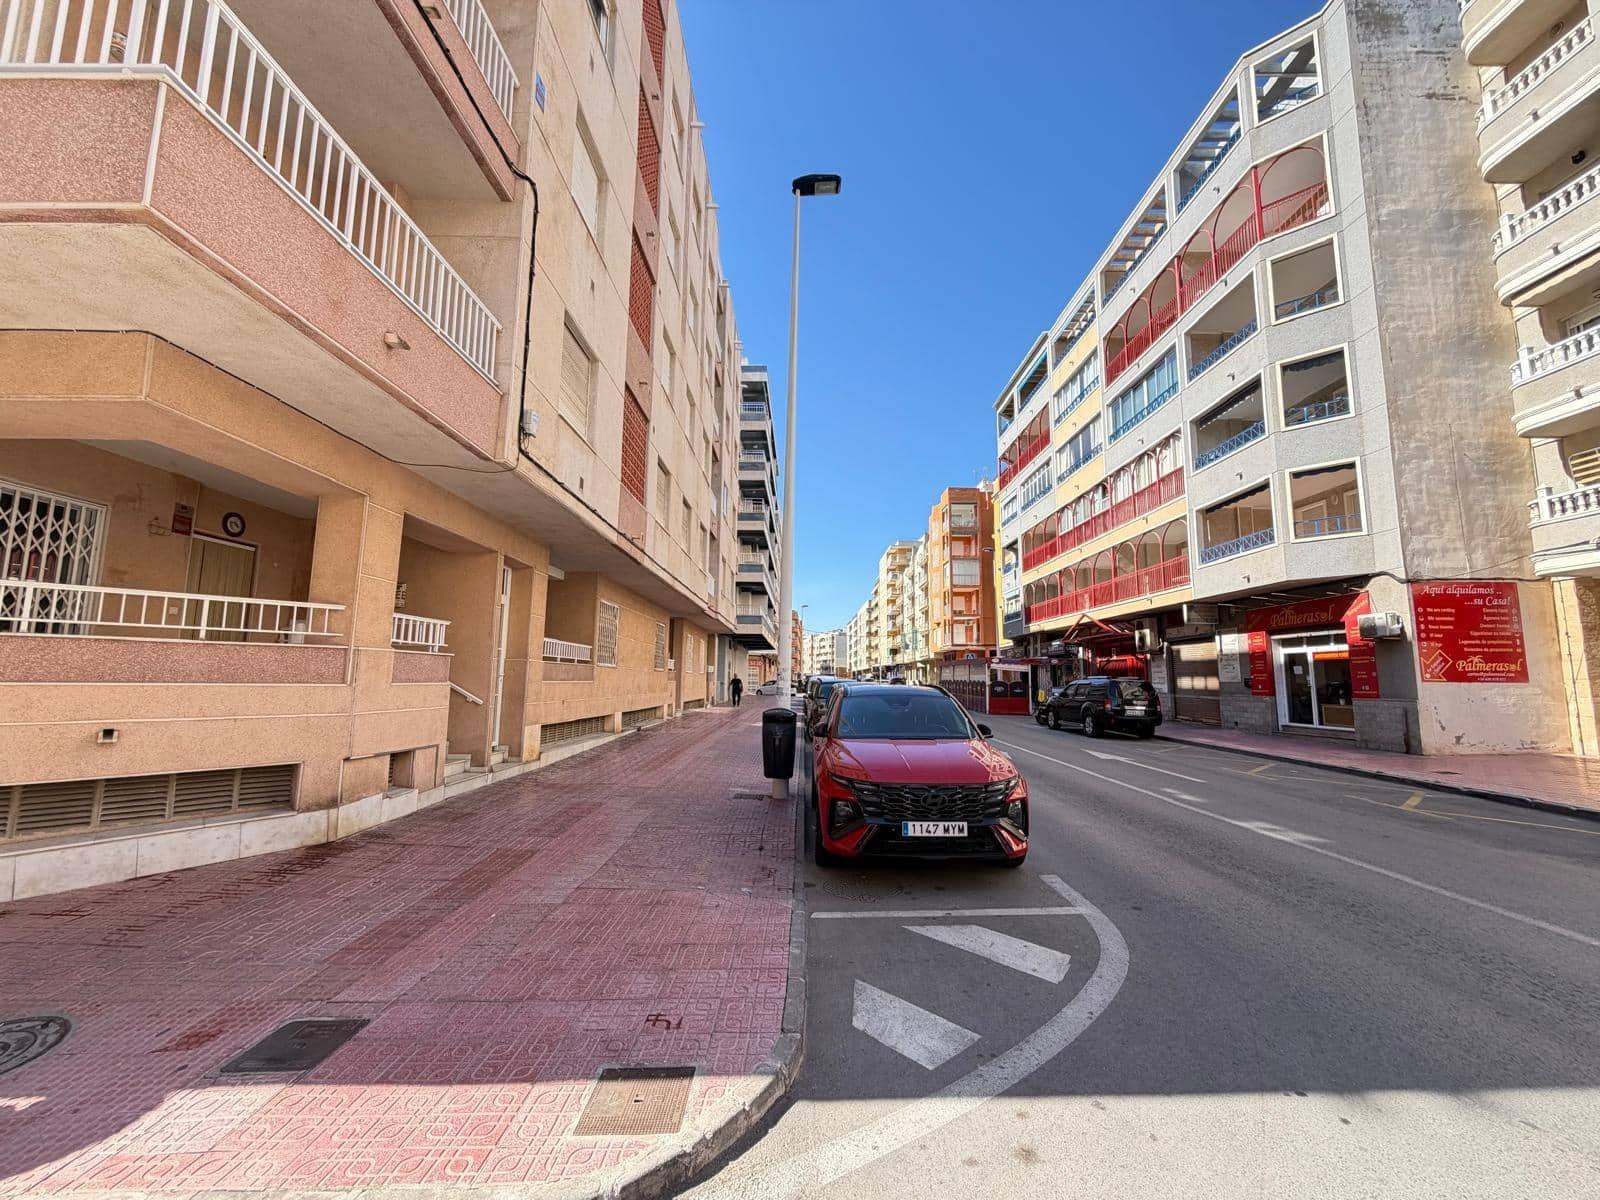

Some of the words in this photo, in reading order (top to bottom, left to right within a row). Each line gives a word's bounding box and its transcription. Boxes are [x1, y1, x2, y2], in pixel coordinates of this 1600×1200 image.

[1446, 583, 1494, 597] alquilamos
[1485, 596, 1511, 606] Casa!
[1269, 603, 1336, 627] Palmerasol
[1456, 658, 1524, 671] Palmerasol
[912, 823, 939, 835] 1147
[943, 823, 965, 835] MYM
